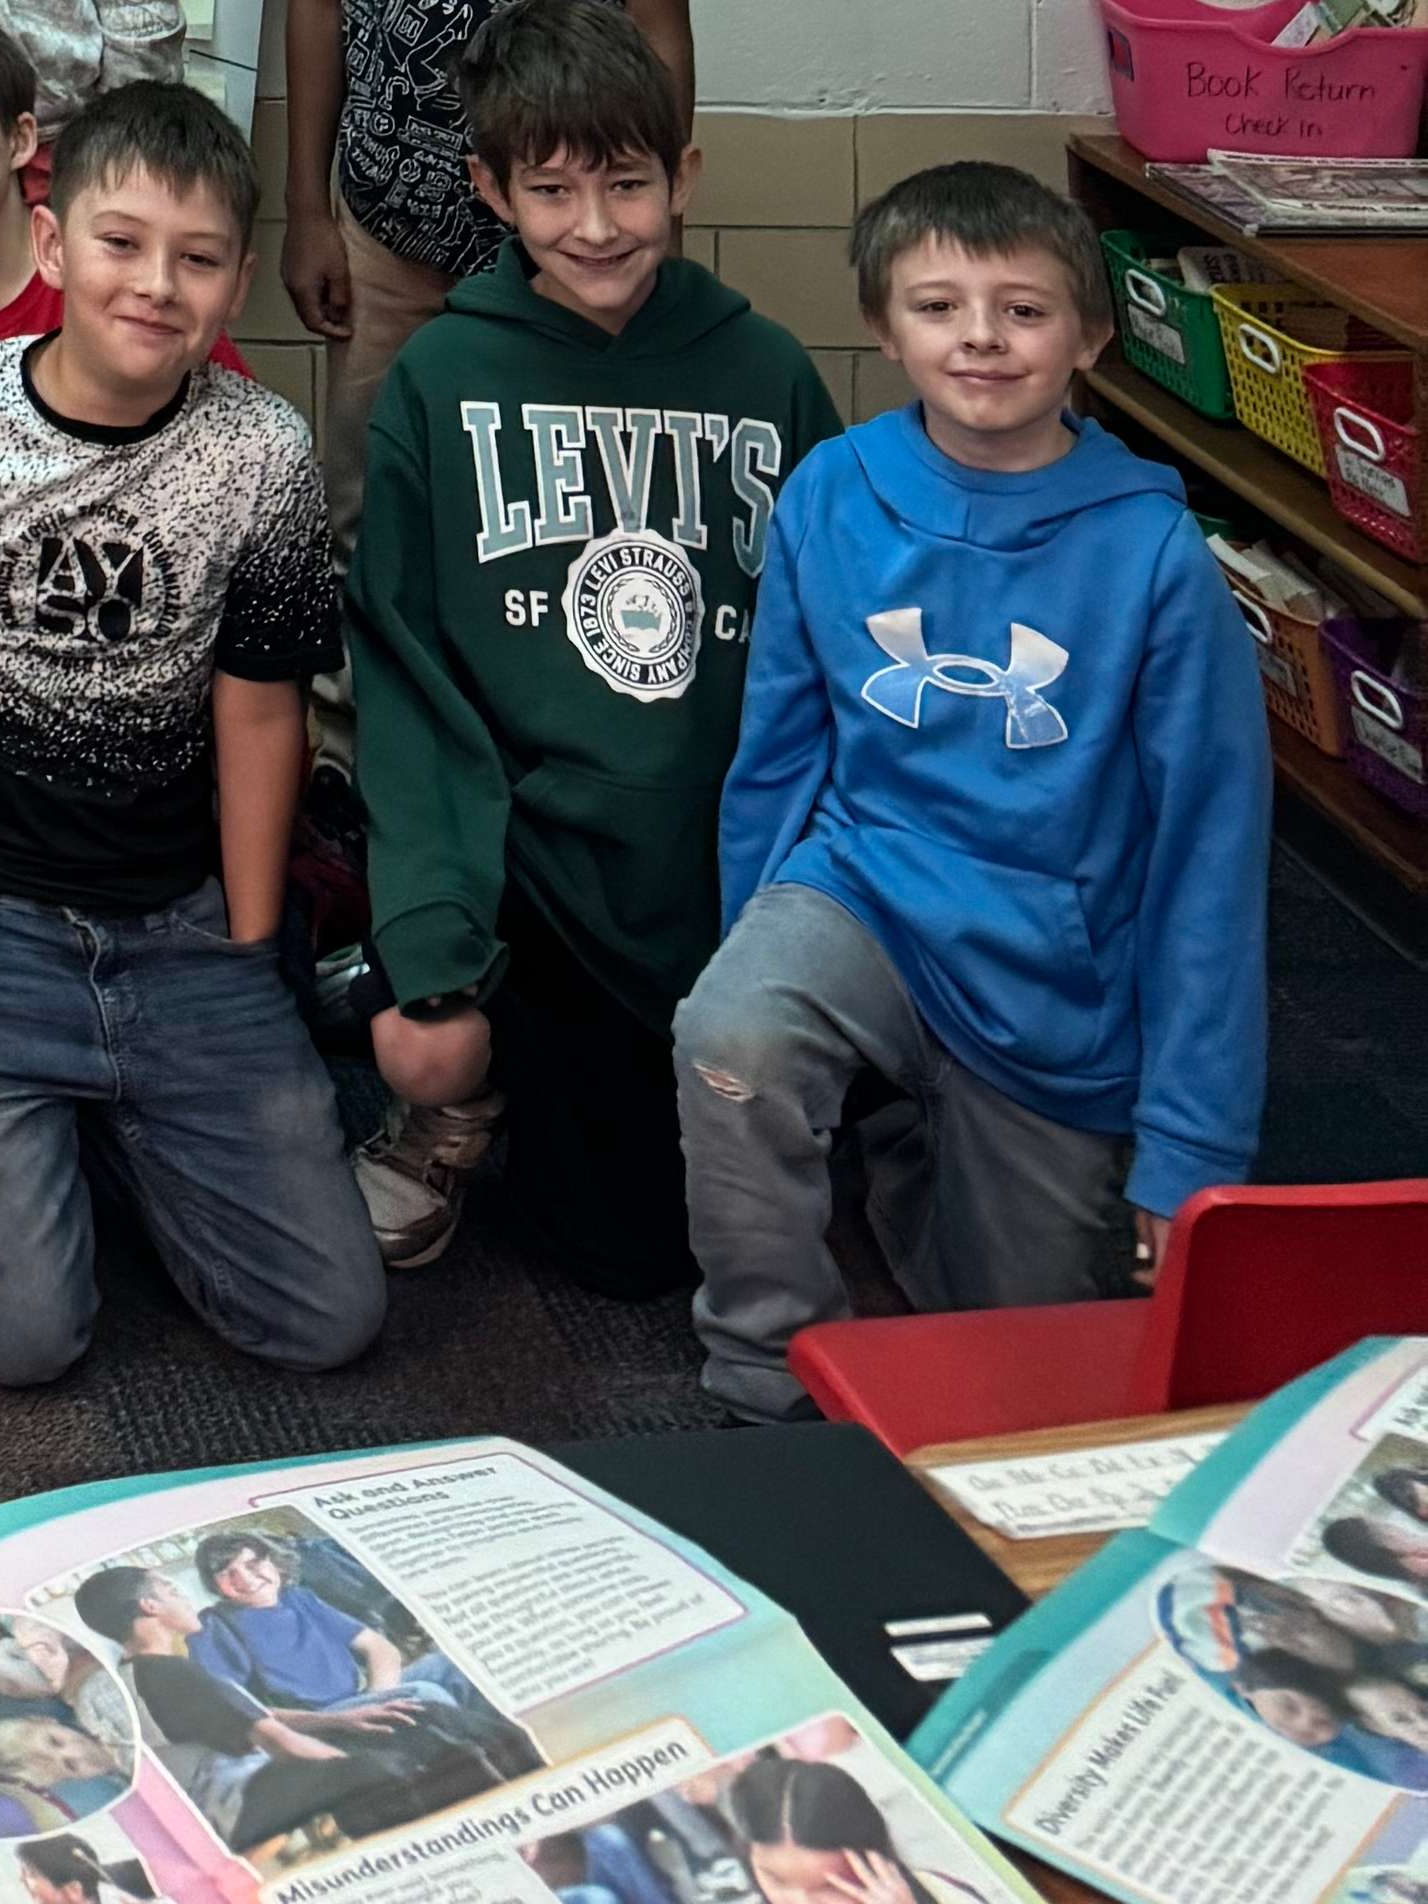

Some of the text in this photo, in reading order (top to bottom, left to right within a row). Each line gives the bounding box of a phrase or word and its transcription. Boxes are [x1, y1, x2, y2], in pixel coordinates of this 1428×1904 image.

[1186, 60, 1376, 103] Book Return
[1225, 113, 1323, 138] Check in
[460, 400, 782, 580] LEVI'S
[585, 553, 619, 592] LEVI
[619, 547, 691, 598] STRAUSS
[505, 589, 549, 628] SF
[580, 593, 601, 638] 1873
[593, 637, 642, 682] SINCE
[313, 1465, 499, 1510] Ask and Answer
[328, 1488, 451, 1522] Questions
[1034, 1718, 1138, 1837] Diversity Makes
[276, 1738, 692, 1904] Misunderstandings Can Happen
